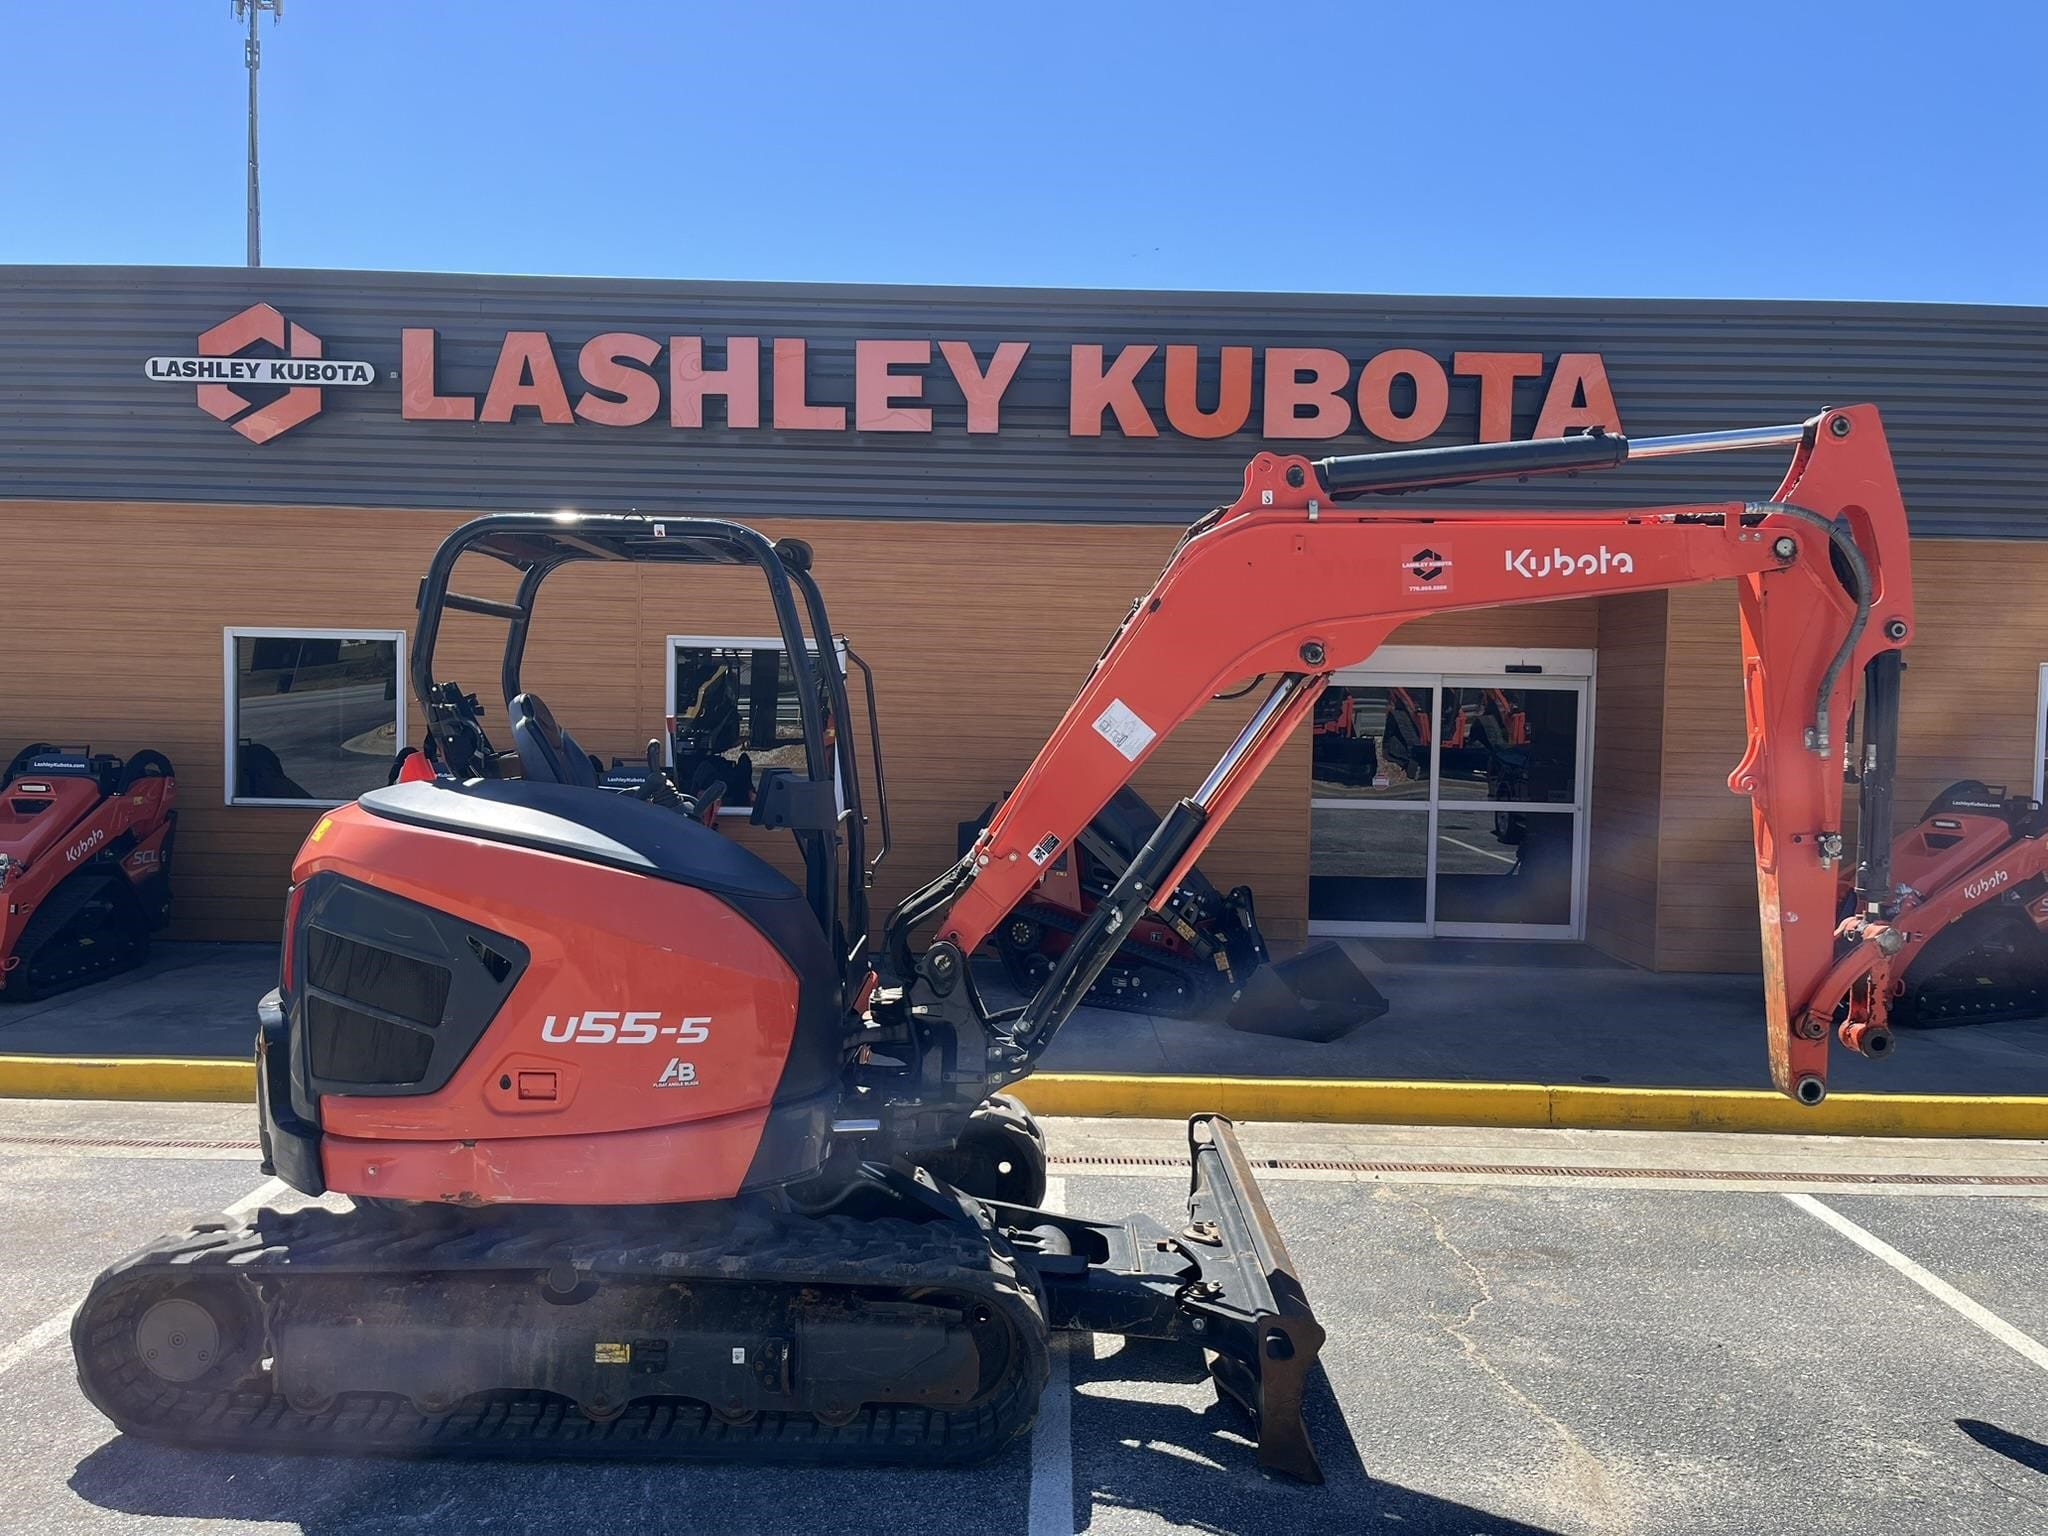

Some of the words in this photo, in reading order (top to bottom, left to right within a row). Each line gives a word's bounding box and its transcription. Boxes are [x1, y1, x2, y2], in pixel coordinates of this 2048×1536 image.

[151, 360, 261, 379] LASHLEY
[270, 363, 369, 382] KUBOTA
[402, 327, 1031, 434] LASHLEY
[1069, 343, 1625, 443] KUBOTA
[1504, 545, 1634, 578] Kubota
[66, 828, 105, 862] Kubota
[1964, 870, 2009, 900] Kubota
[541, 1011, 712, 1044] U55-5
